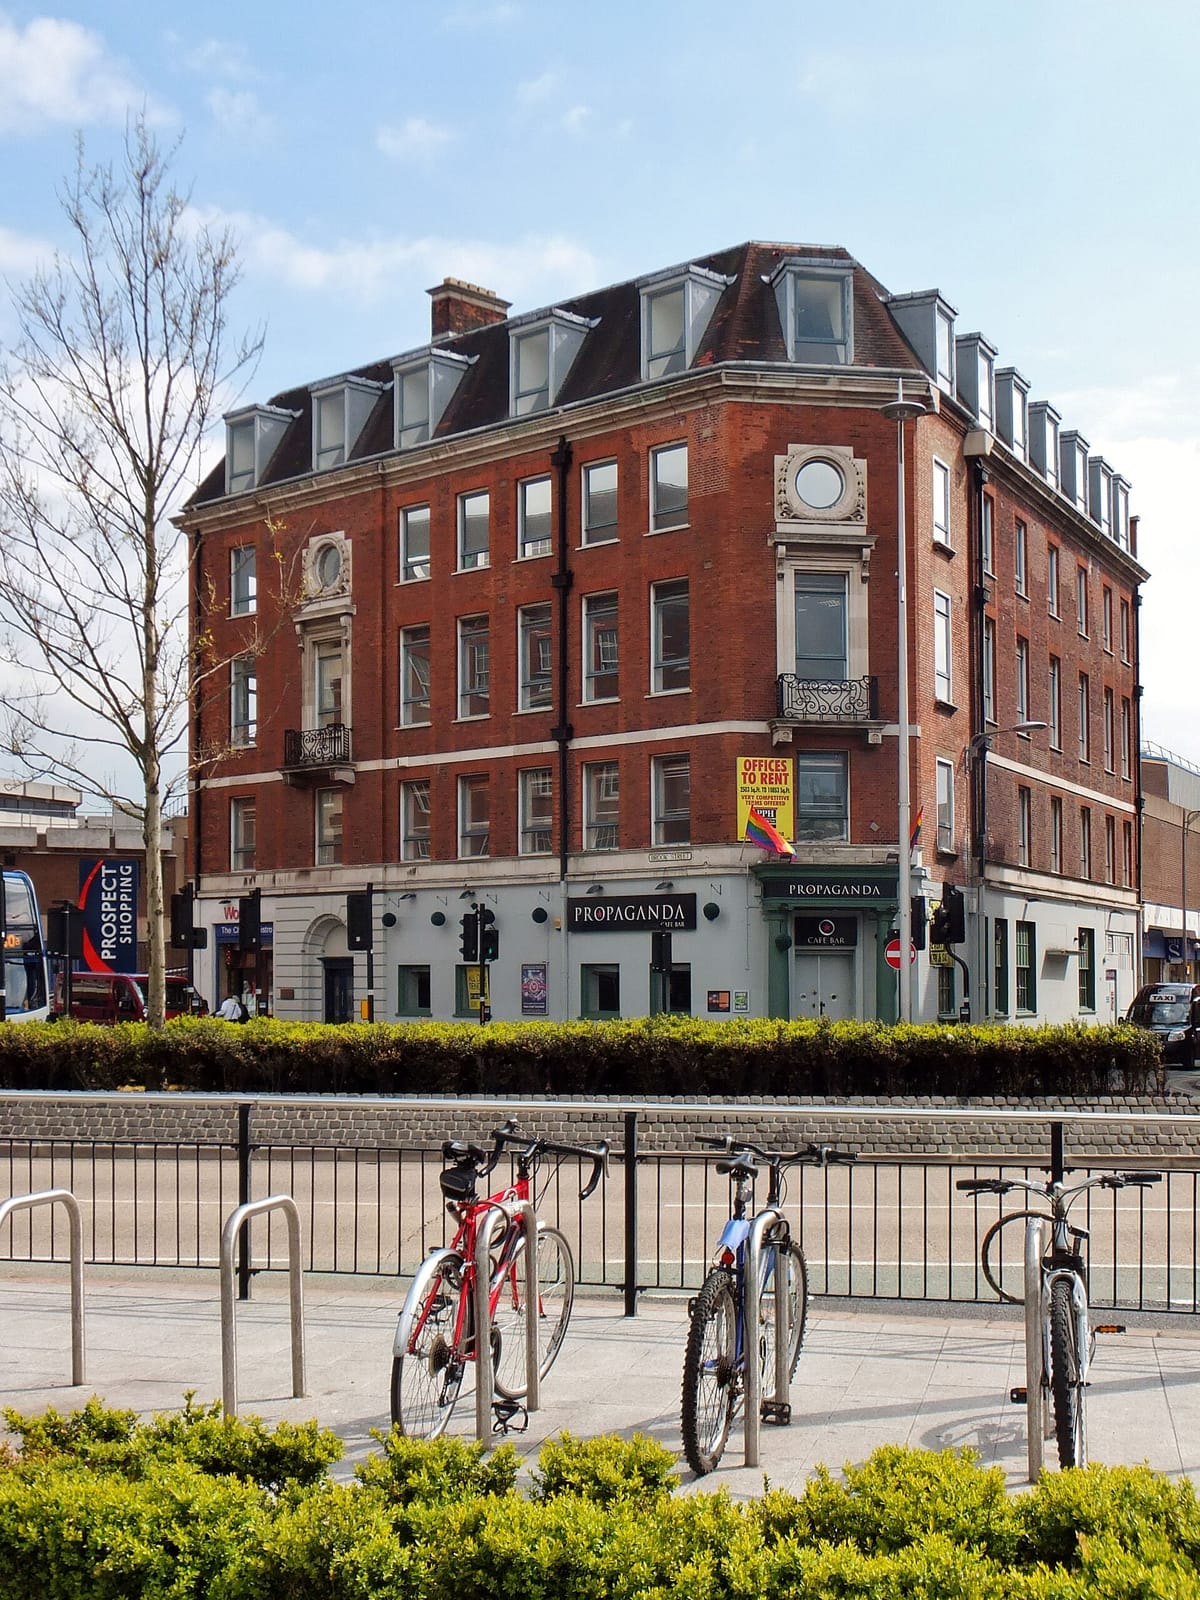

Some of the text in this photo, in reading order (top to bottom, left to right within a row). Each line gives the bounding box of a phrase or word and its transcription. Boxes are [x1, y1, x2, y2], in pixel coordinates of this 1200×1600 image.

[743, 759, 787, 772] OFFICES
[741, 772, 790, 785] TO RENT
[789, 884, 881, 895] PROPAGANDA
[120, 865, 132, 944] SHOPPING
[101, 865, 117, 960] PROSPECT
[223, 905, 240, 920] Wo
[575, 903, 685, 922] PROPAGANDA
[221, 926, 232, 934] The
[807, 936, 845, 944] CAFE BAR
